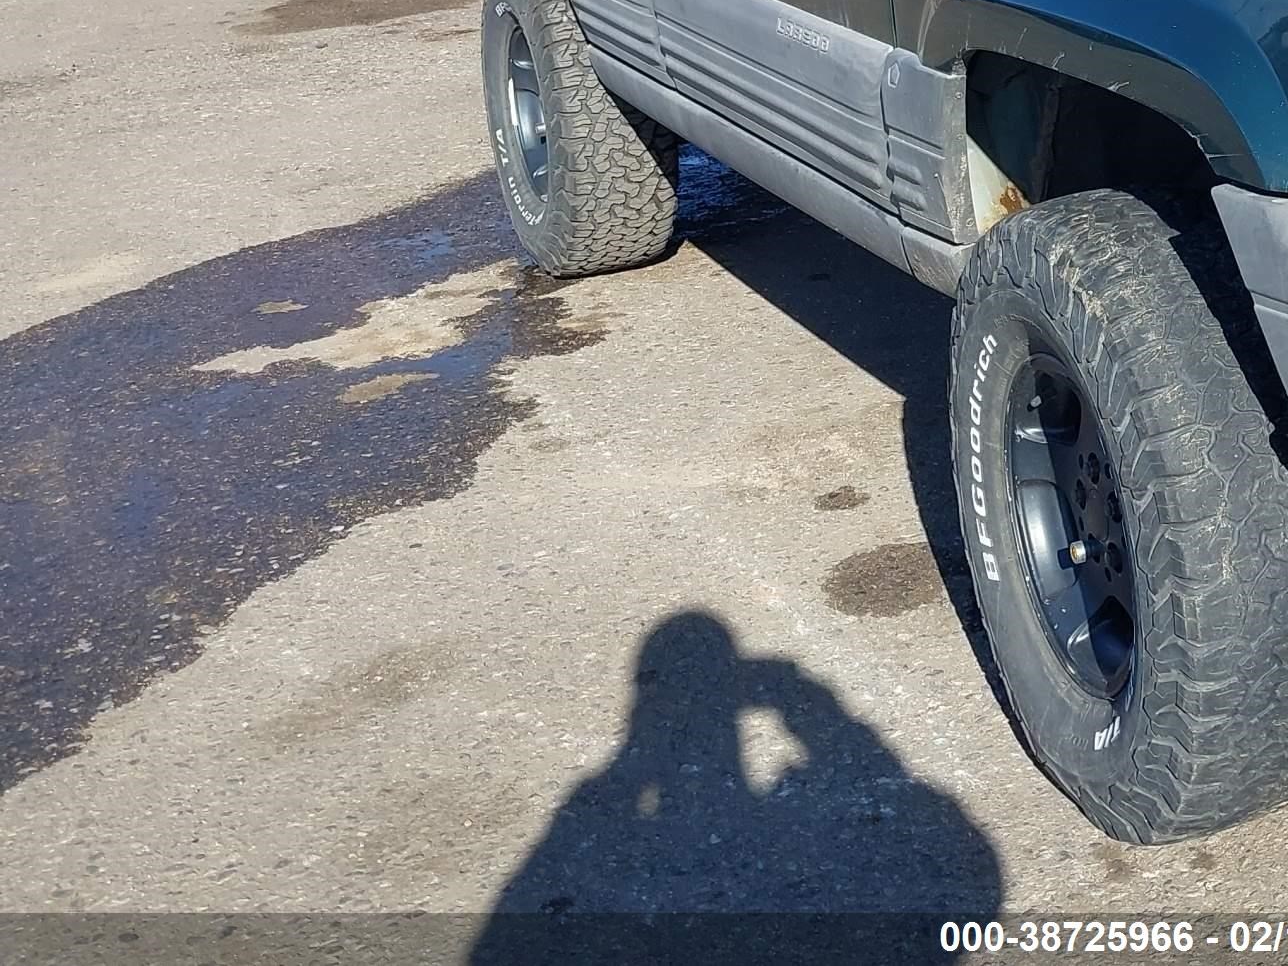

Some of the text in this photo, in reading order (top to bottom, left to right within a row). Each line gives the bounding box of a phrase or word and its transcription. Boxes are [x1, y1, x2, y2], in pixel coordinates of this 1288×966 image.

[495, 128, 510, 167] T/A
[969, 334, 1000, 582] BFGoodrich
[1094, 716, 1121, 751] T/A
